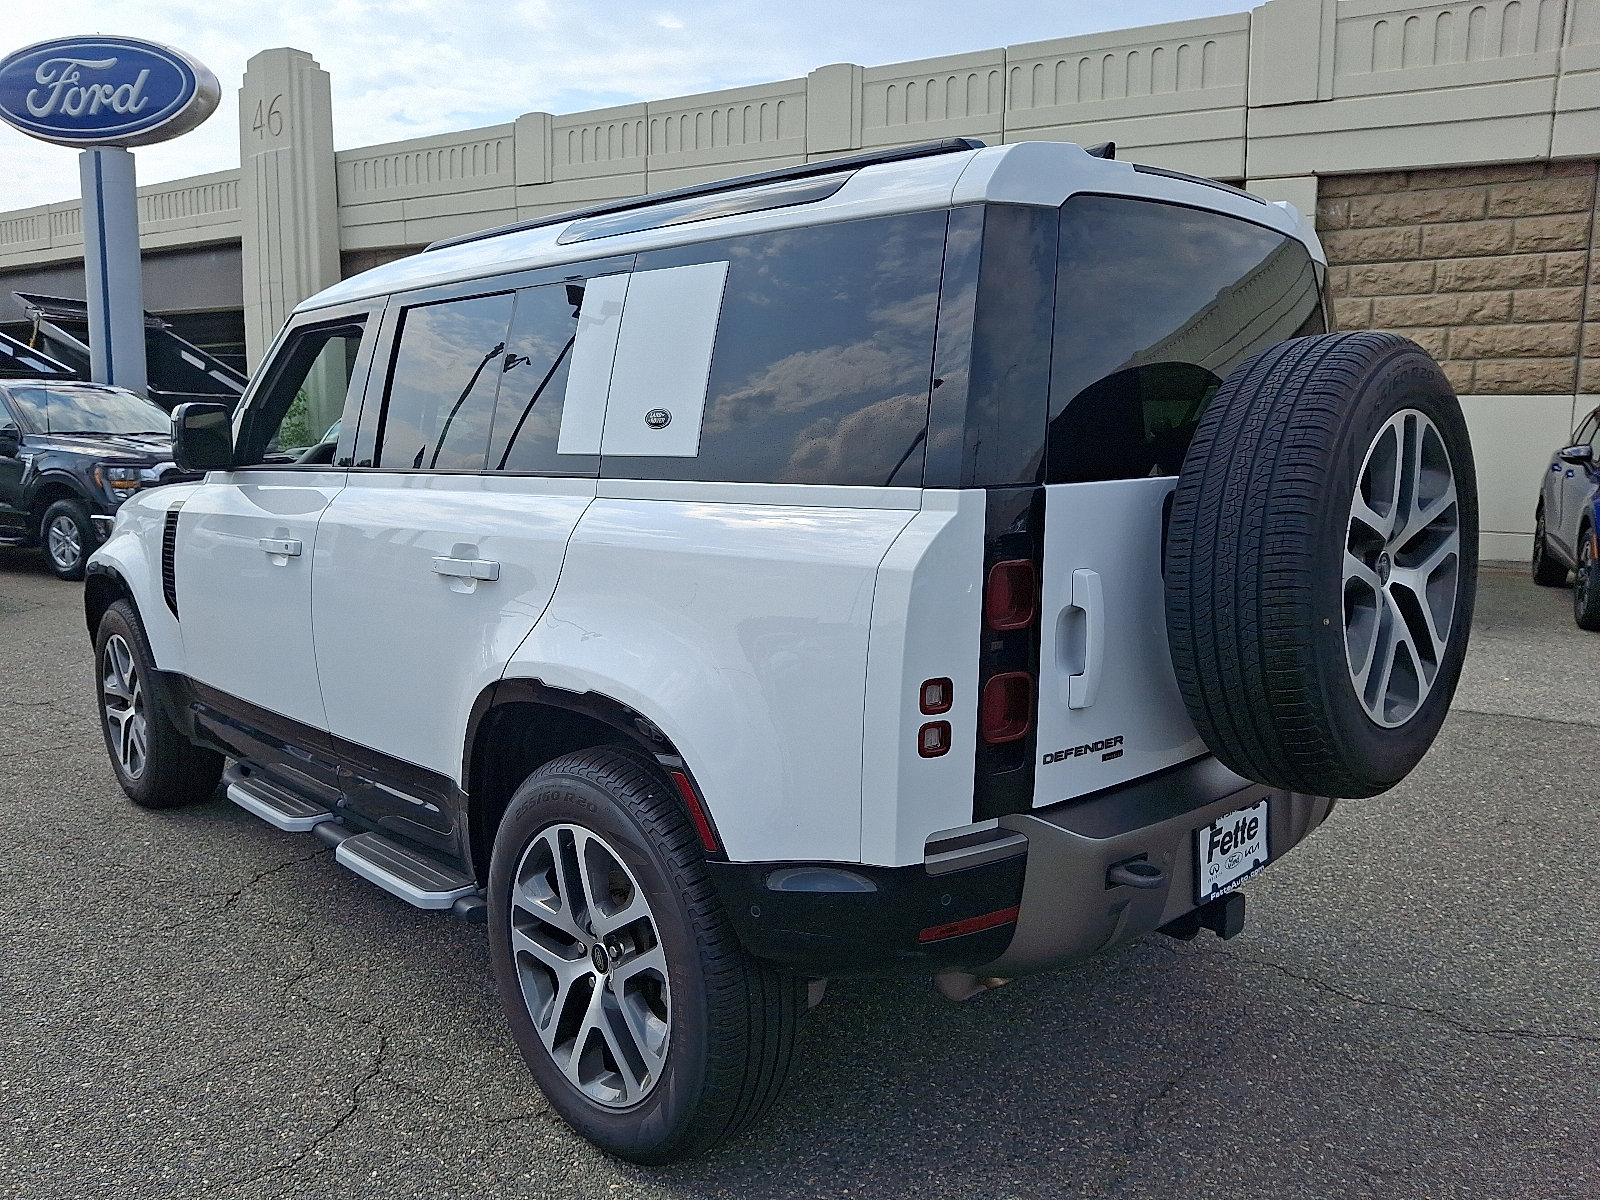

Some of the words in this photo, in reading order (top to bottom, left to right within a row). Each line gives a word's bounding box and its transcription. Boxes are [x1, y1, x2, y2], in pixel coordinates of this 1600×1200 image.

[27, 57, 150, 118] Ford
[252, 93, 283, 140] 46
[1042, 735, 1124, 765] DEFENDER
[1206, 816, 1259, 865] Fette
[1210, 865, 1265, 901] FetteAuto.com
